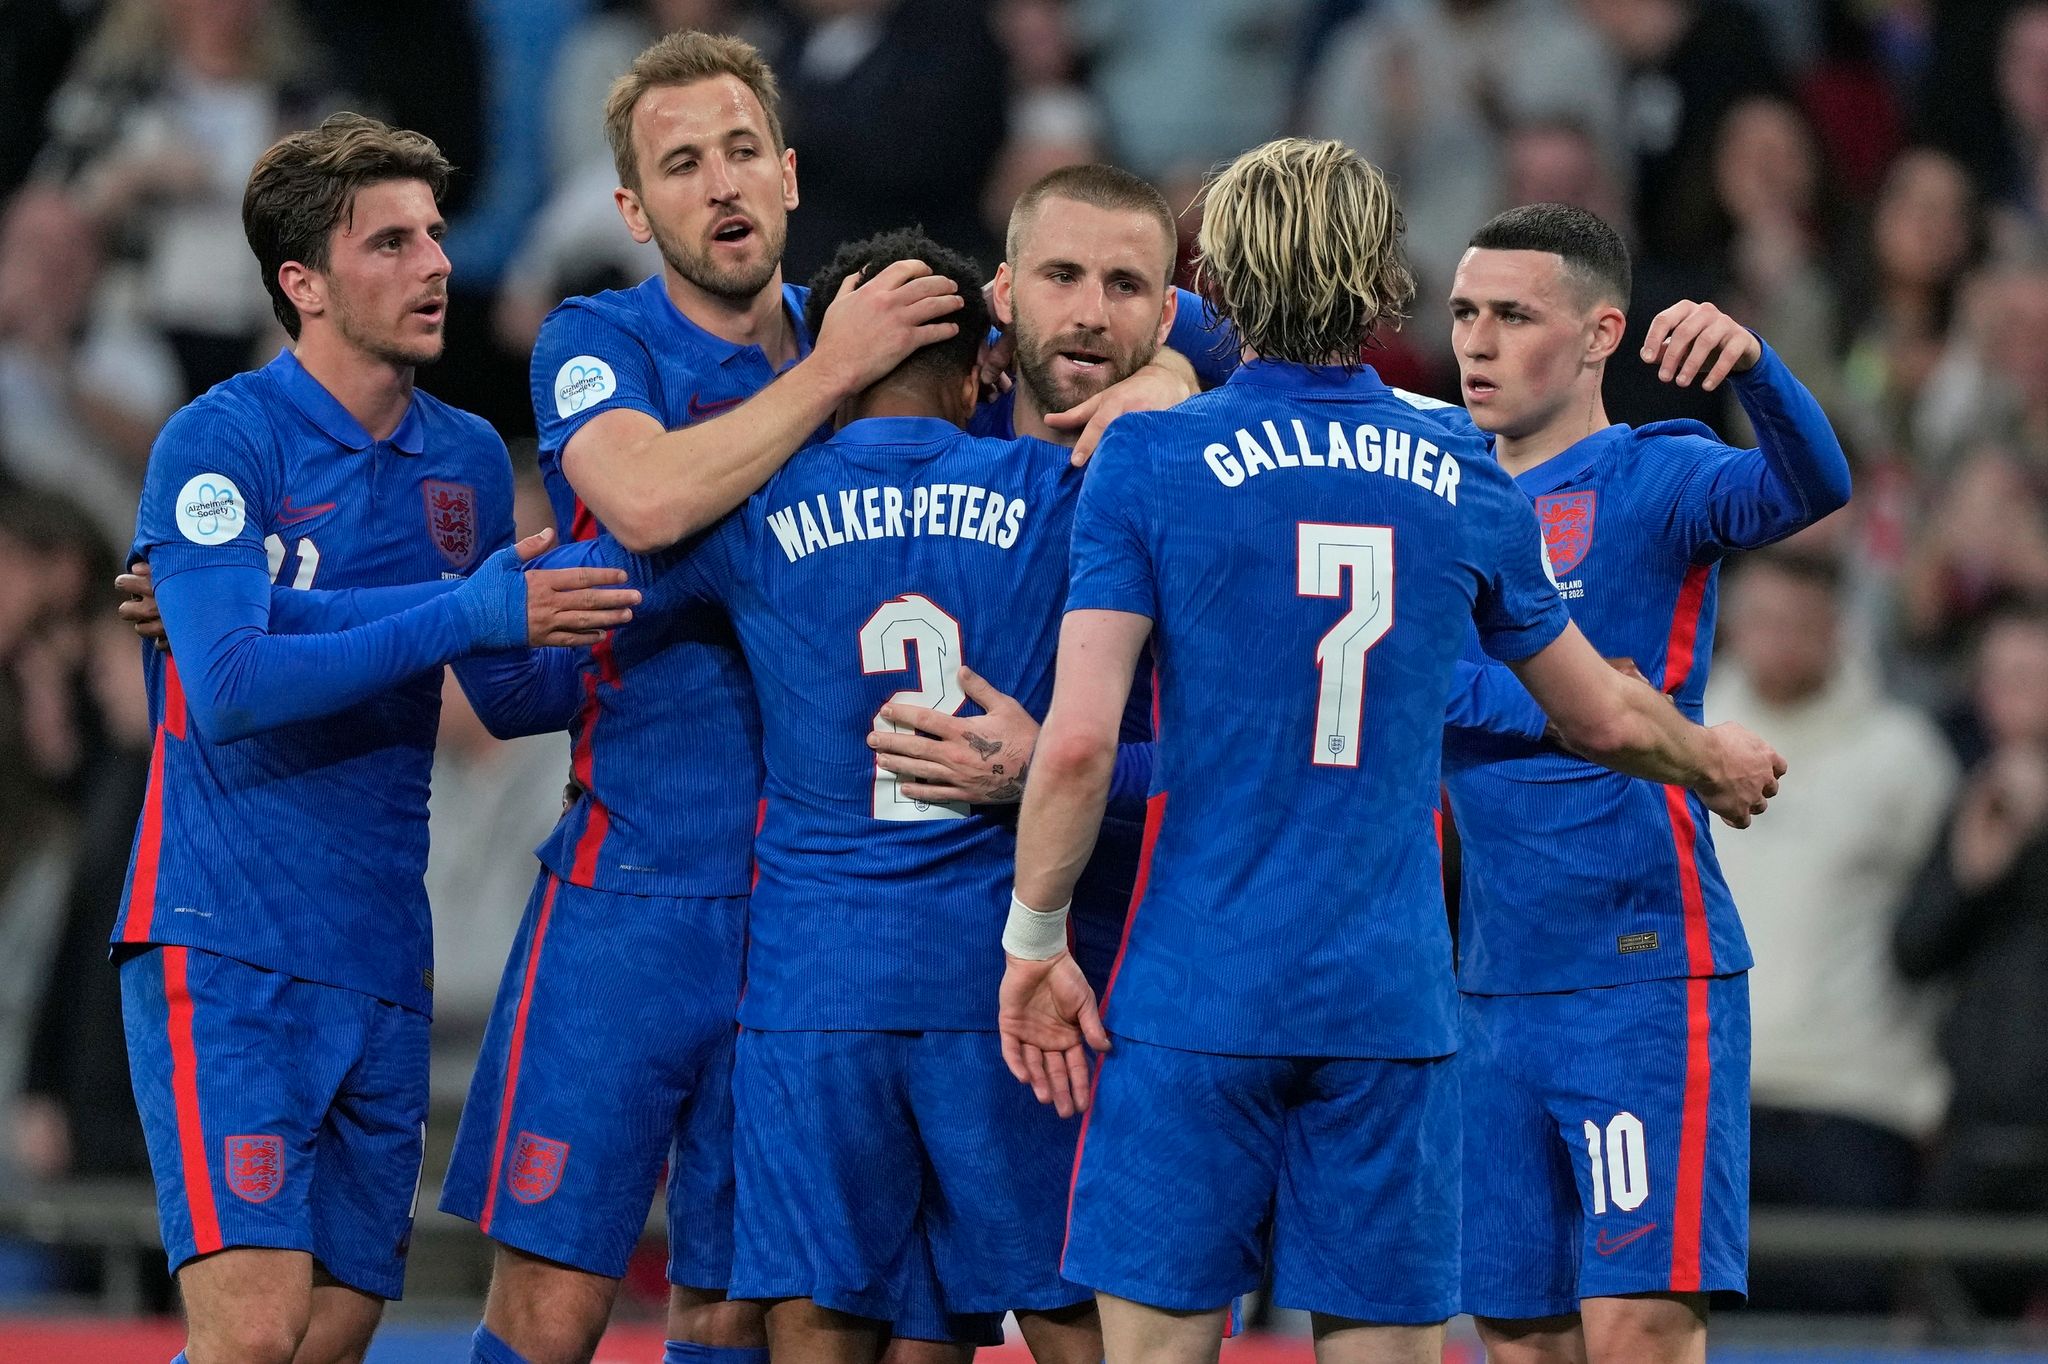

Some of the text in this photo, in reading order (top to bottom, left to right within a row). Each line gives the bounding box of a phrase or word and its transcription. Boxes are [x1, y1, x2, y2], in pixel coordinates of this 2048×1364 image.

[562, 375, 604, 396] Alzheimer's
[568, 383, 597, 396] Society
[1203, 419, 1461, 507] GALLAGHER
[188, 499, 234, 513] Alzheimer's
[197, 507, 229, 518] Society
[766, 483, 1027, 563] WALKER-PETERS
[263, 533, 320, 590] 11
[1556, 579, 1583, 591] ERLAND
[1568, 589, 1585, 599] 2022
[1297, 521, 1394, 768] 7
[858, 592, 971, 822] 2
[1583, 1111, 1649, 1215] 10
